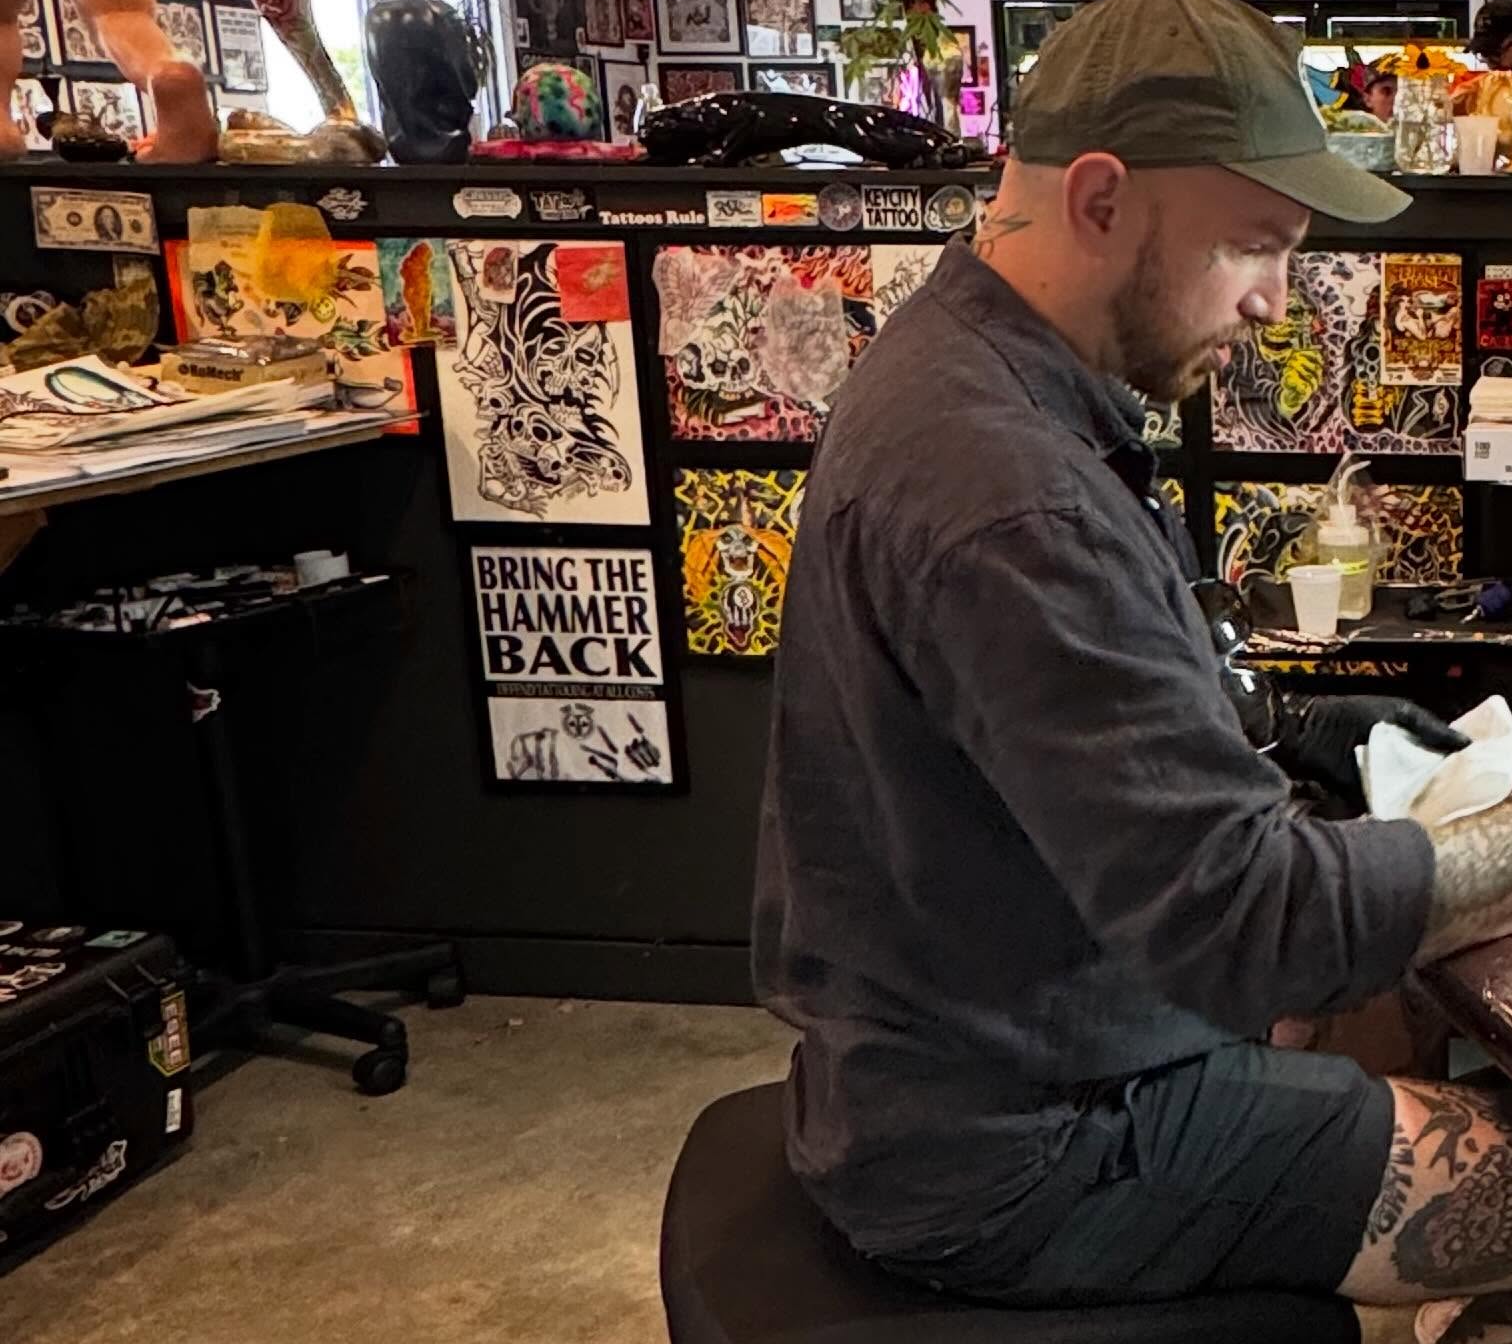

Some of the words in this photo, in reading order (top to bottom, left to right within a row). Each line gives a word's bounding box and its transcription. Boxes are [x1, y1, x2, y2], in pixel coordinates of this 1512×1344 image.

[864, 188, 919, 207] KEYCITY
[600, 210, 663, 225] Tattoos
[666, 210, 705, 225] Rule
[865, 208, 919, 227] TATTOO
[477, 556, 578, 591] BRING
[584, 558, 648, 593] THE
[481, 592, 652, 634] HAMMER
[485, 634, 657, 677] BACK
